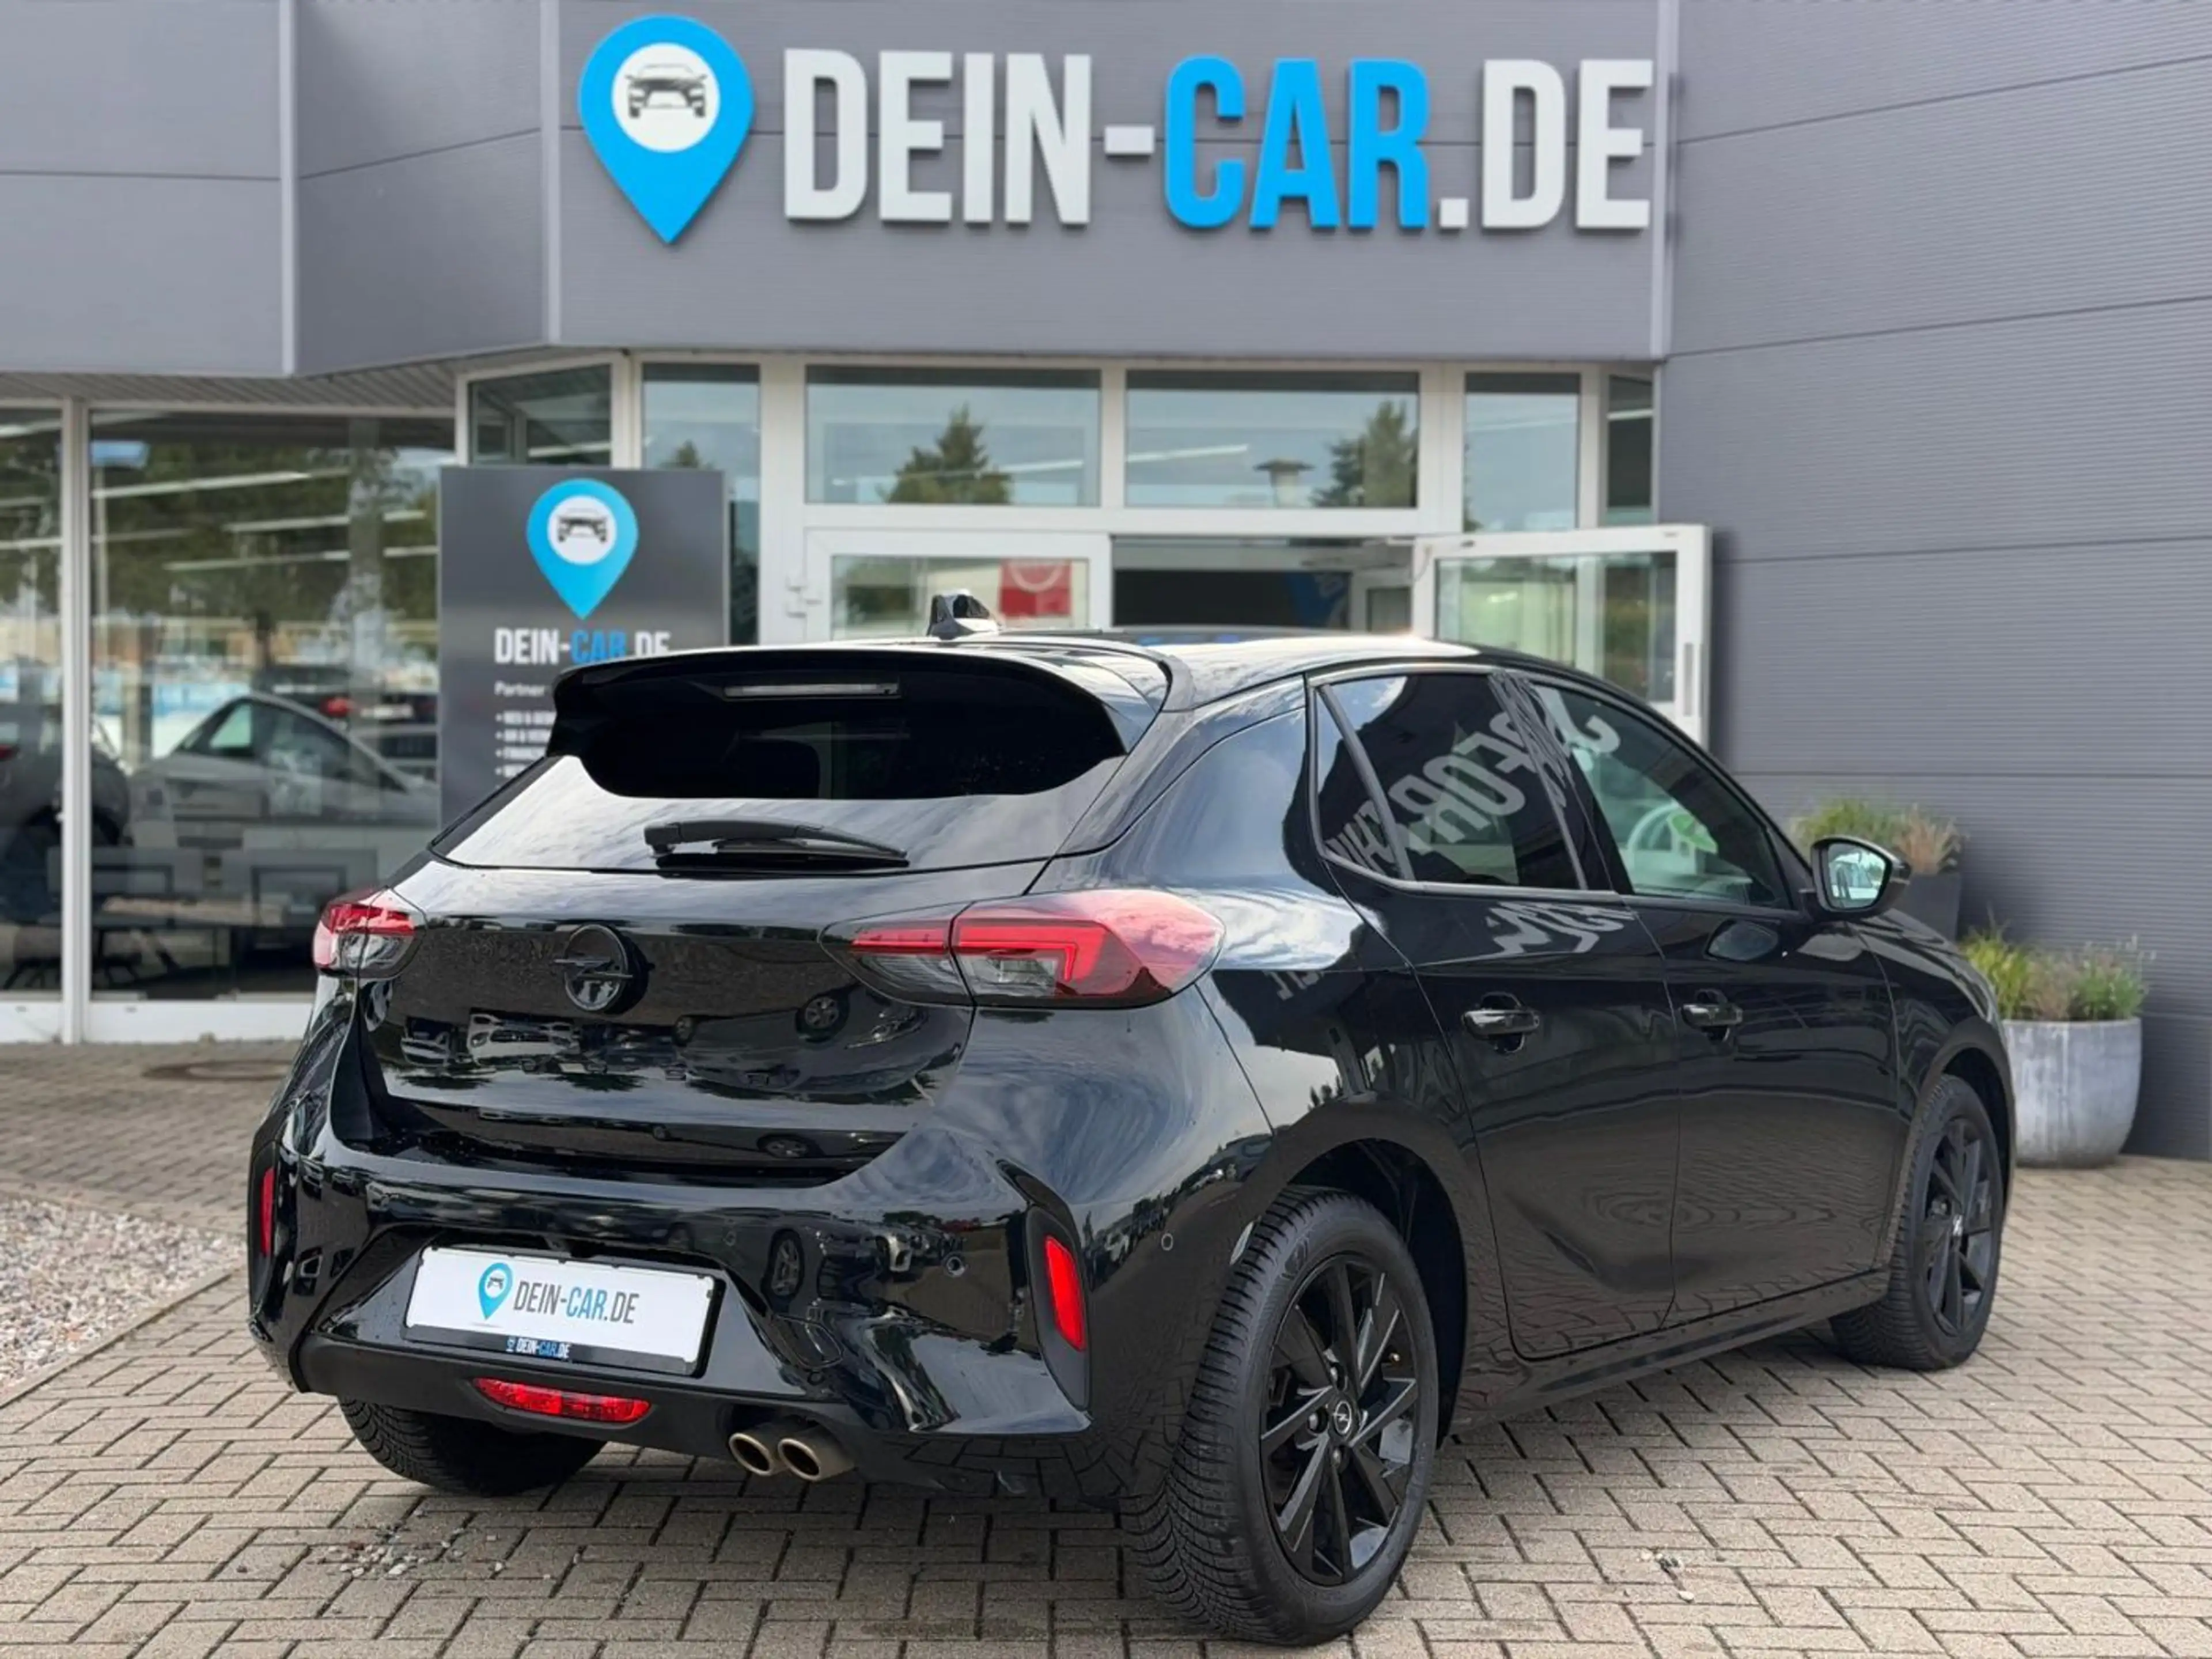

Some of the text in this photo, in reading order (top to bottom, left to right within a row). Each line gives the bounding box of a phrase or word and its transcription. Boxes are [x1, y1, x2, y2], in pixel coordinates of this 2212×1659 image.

[783, 48, 1652, 229] DEIN-CAR.DE
[494, 627, 671, 665] DEIN-CARDE
[513, 1280, 639, 1324] DEIN-CAR.DE
